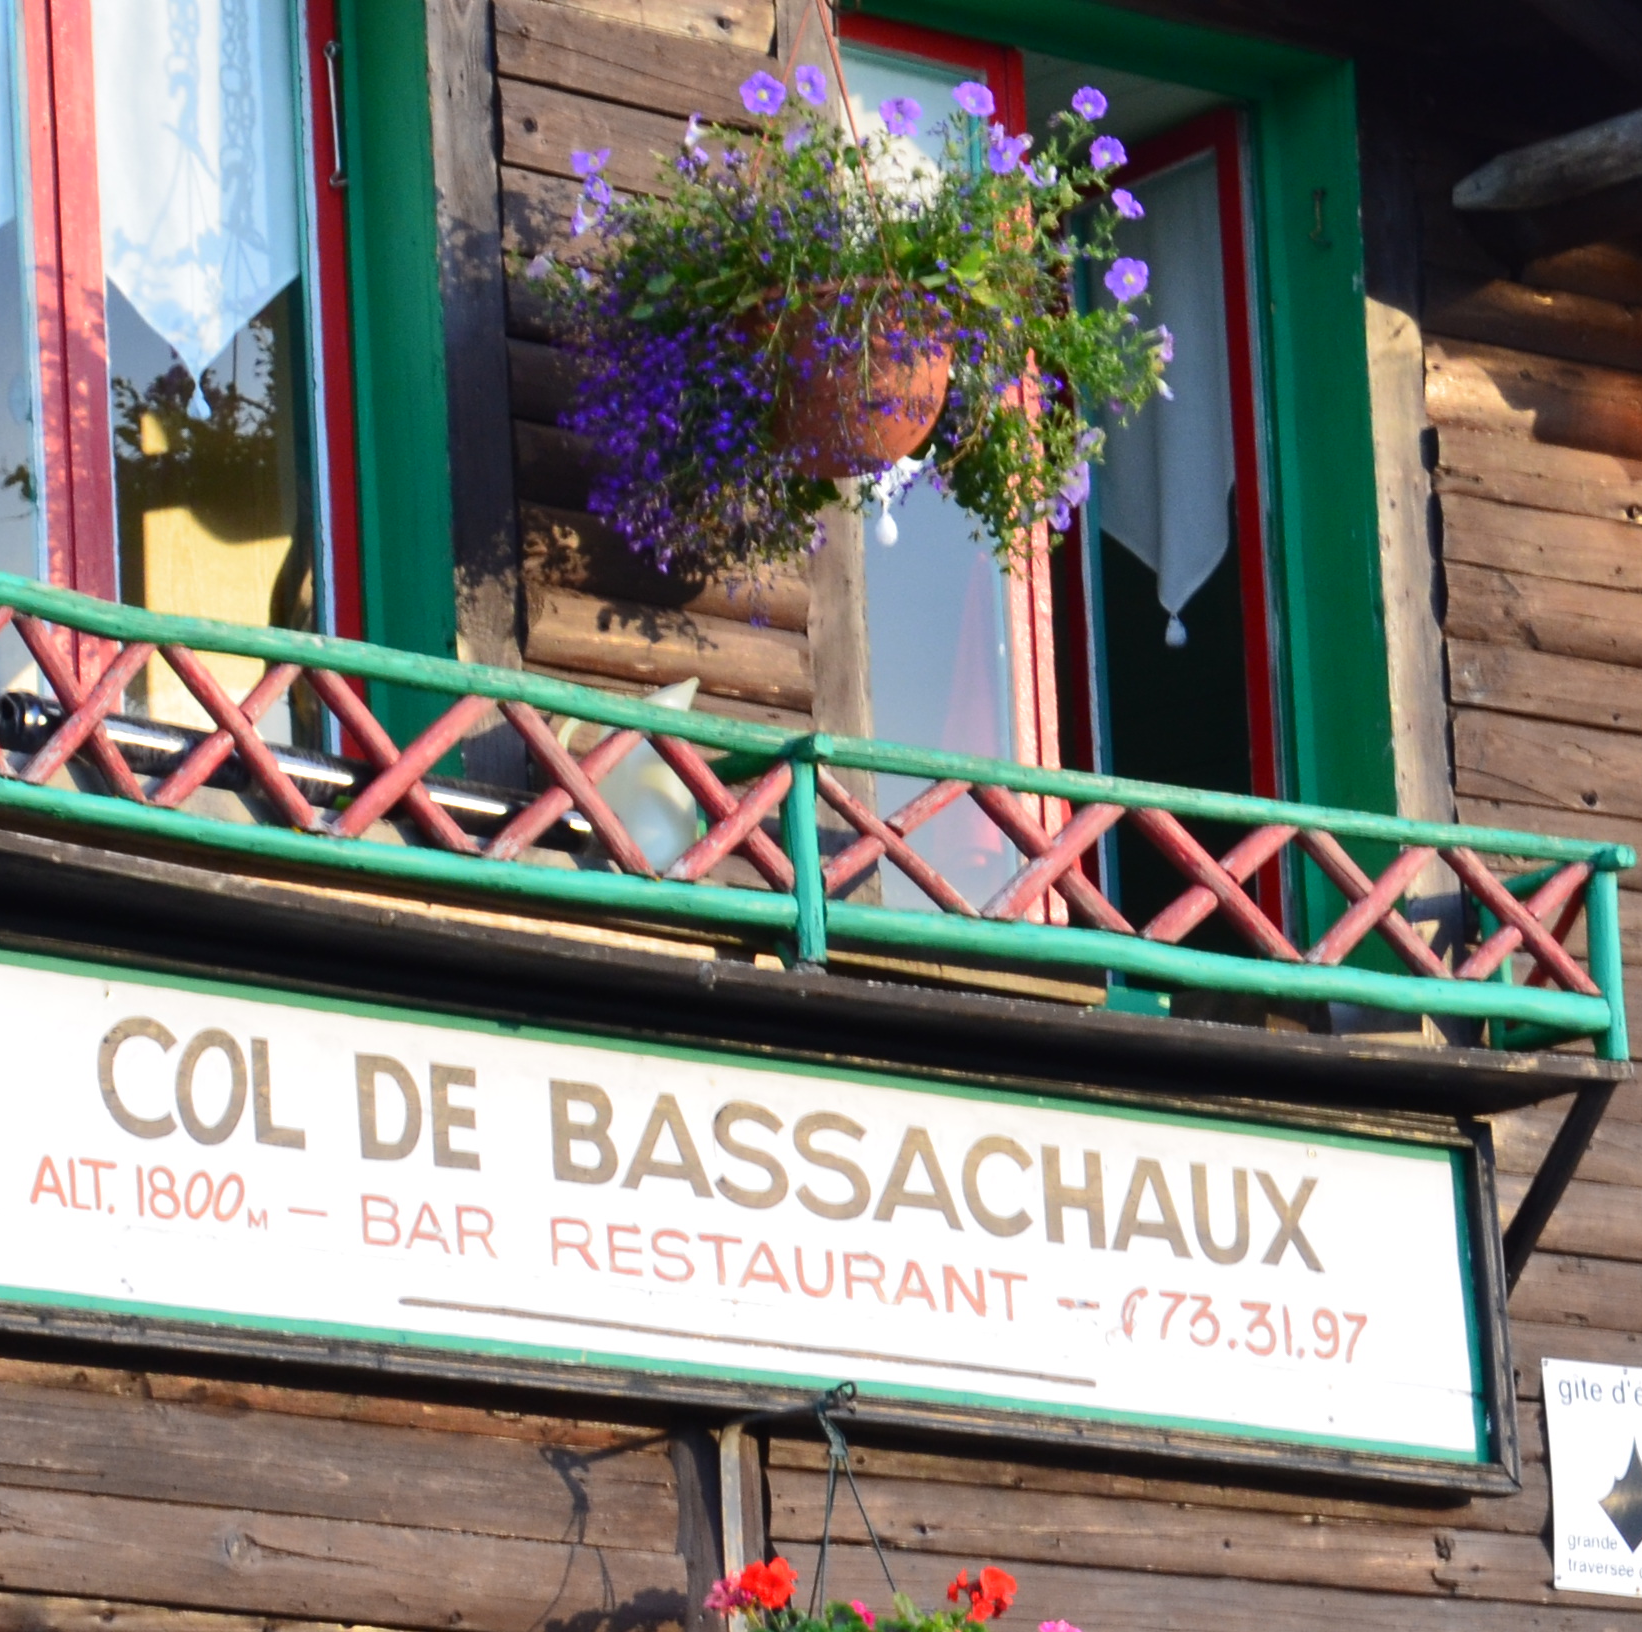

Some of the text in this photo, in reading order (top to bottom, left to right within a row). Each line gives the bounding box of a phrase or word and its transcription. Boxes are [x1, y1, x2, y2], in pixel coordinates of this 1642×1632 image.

[98, 1017, 1324, 1273] COL DE BASSACHAUX
[30, 1155, 117, 1215] ALT.
[360, 1194, 499, 1259] BAR
[550, 1217, 1028, 1321] RESTAURANT
[1567, 1533, 1618, 1551] grande
